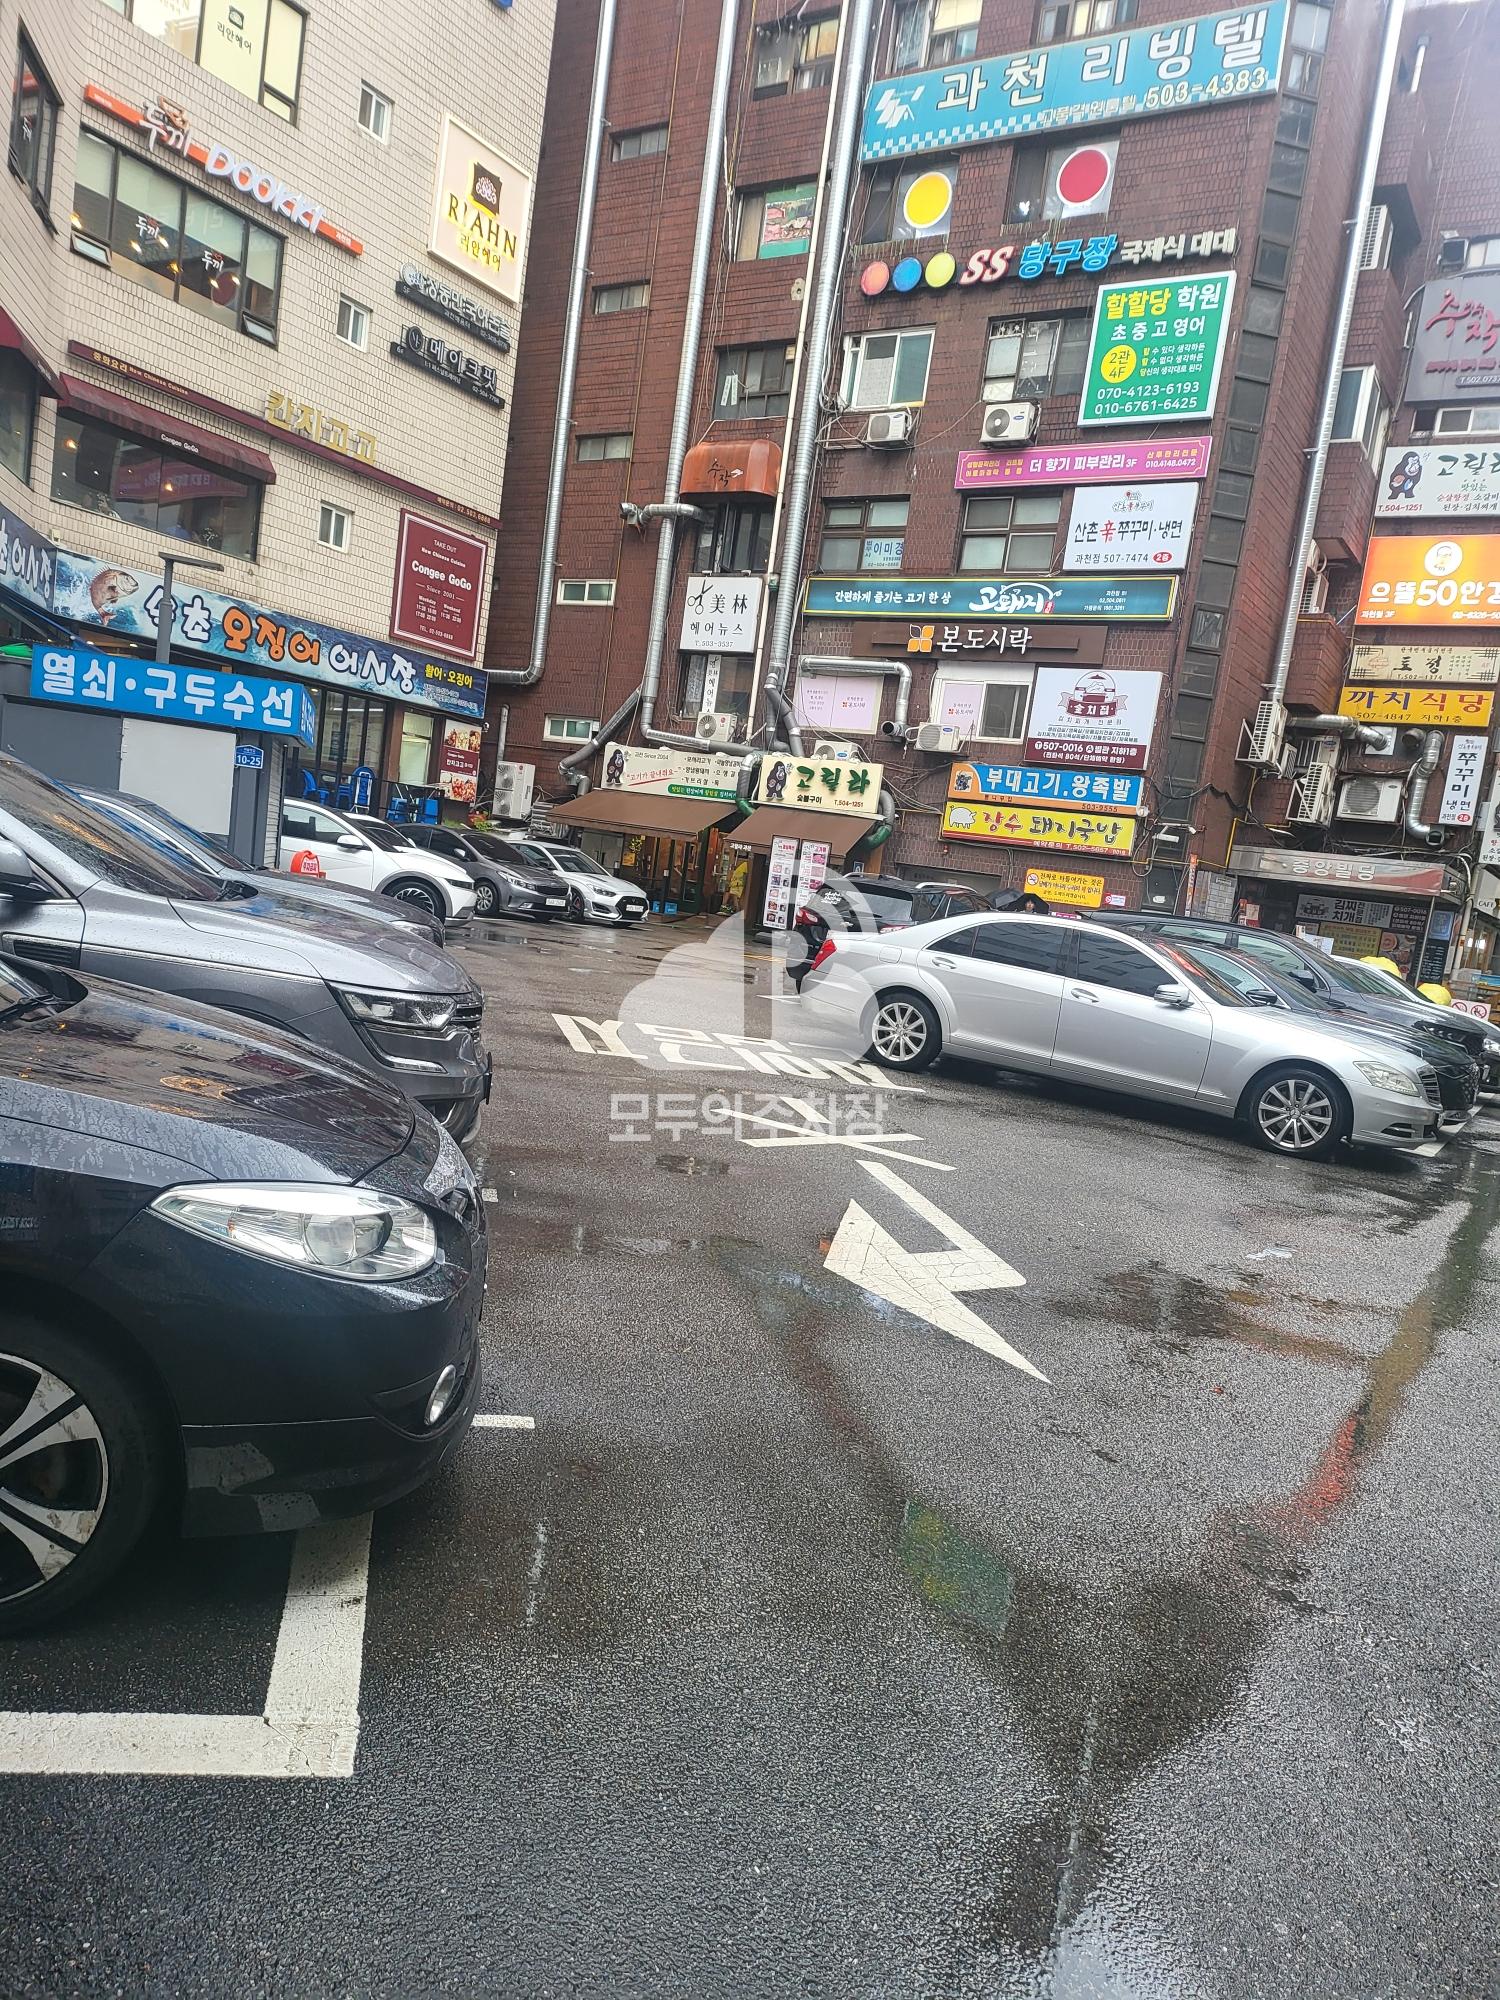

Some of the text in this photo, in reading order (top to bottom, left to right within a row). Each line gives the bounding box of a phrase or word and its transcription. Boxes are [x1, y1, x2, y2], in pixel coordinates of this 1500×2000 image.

[217, 22, 253, 55] 리안헤어
[937, 9, 1267, 112] 과천 리빙텔
[1143, 68, 1269, 109] 503-4383
[140, 101, 325, 233] 두끼 DOOKKI
[136, 215, 160, 238] 두끼
[449, 193, 517, 259] RIAHN
[202, 250, 224, 271] 두끼
[960, 227, 1236, 285] SS 당구장 국제식 대대
[1107, 282, 1222, 320] 할할당 학원
[1111, 316, 1206, 340] 초 중 고 영어
[1109, 350, 1131, 364] 2관
[1152, 346, 1160, 355] 수
[1161, 345, 1176, 354] 있다
[93, 351, 189, 395] 중화요리 New Chinese Cuisine
[430, 339, 498, 392] 메이크핏
[1109, 366, 1127, 378] 4F
[1097, 382, 1200, 400] 070-4123-6193
[1094, 397, 1198, 415] 010-6761-6425
[1029, 458, 1043, 473] 더
[1045, 456, 1071, 472] 향기
[1074, 454, 1126, 471] 피부관리
[1126, 459, 1138, 468] 3F
[1377, 503, 1423, 512] T.504-1251
[421, 547, 466, 568] New Chinese Cuisine
[433, 539, 457, 554] TAKE OUT
[0, 518, 52, 600] 어시장
[1075, 553, 1100, 564] 과천점
[1104, 553, 1149, 563] 507-7474
[411, 560, 472, 591] Congee GoGo
[426, 585, 455, 600] Since 2001
[710, 593, 748, 614] 美林
[835, 590, 951, 604] 간편하게 즐기는 고기 한 상
[690, 622, 743, 636] 헤어뉴스
[937, 624, 1032, 655] 본도시락
[223, 606, 321, 664] 오징어
[329, 644, 416, 694] 어시장
[1346, 691, 1490, 714] 까치식당
[1356, 712, 1412, 721] 507-4847
[1043, 742, 1084, 752] 507-0016
[236, 754, 261, 766] 10-25
[796, 765, 870, 794] 고릴라
[1452, 752, 1478, 798] 쭈꾸미
[834, 800, 864, 808] T.504-1251
[1446, 800, 1471, 811] 냉면
[983, 811, 1122, 843] 장수 돼지국밥
[1292, 859, 1376, 882] 중앙빌딩
